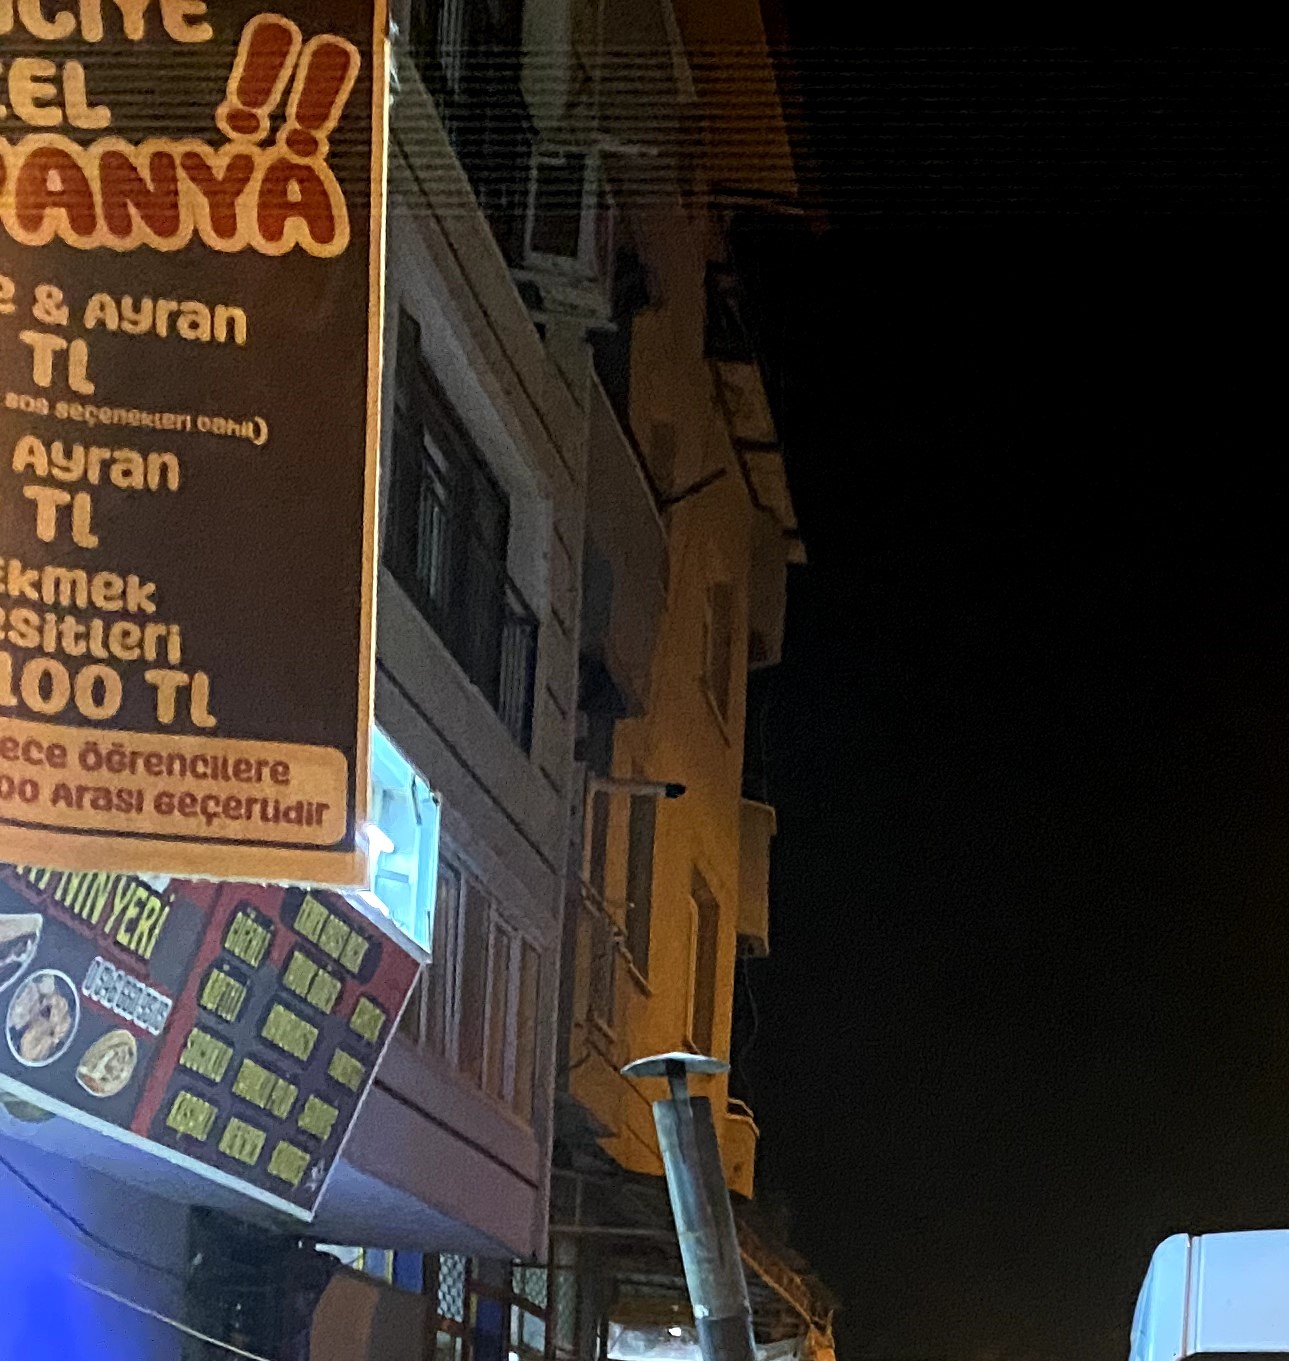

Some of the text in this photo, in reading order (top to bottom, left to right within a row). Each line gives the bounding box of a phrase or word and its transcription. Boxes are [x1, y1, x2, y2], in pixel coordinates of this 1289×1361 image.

[0, 57, 112, 129] EL
[0, 136, 348, 257] ANYA
[83, 291, 247, 346] Ayran
[12, 434, 181, 492] Ayran
[0, 556, 157, 614] kmek
[0, 607, 182, 664] sitleri
